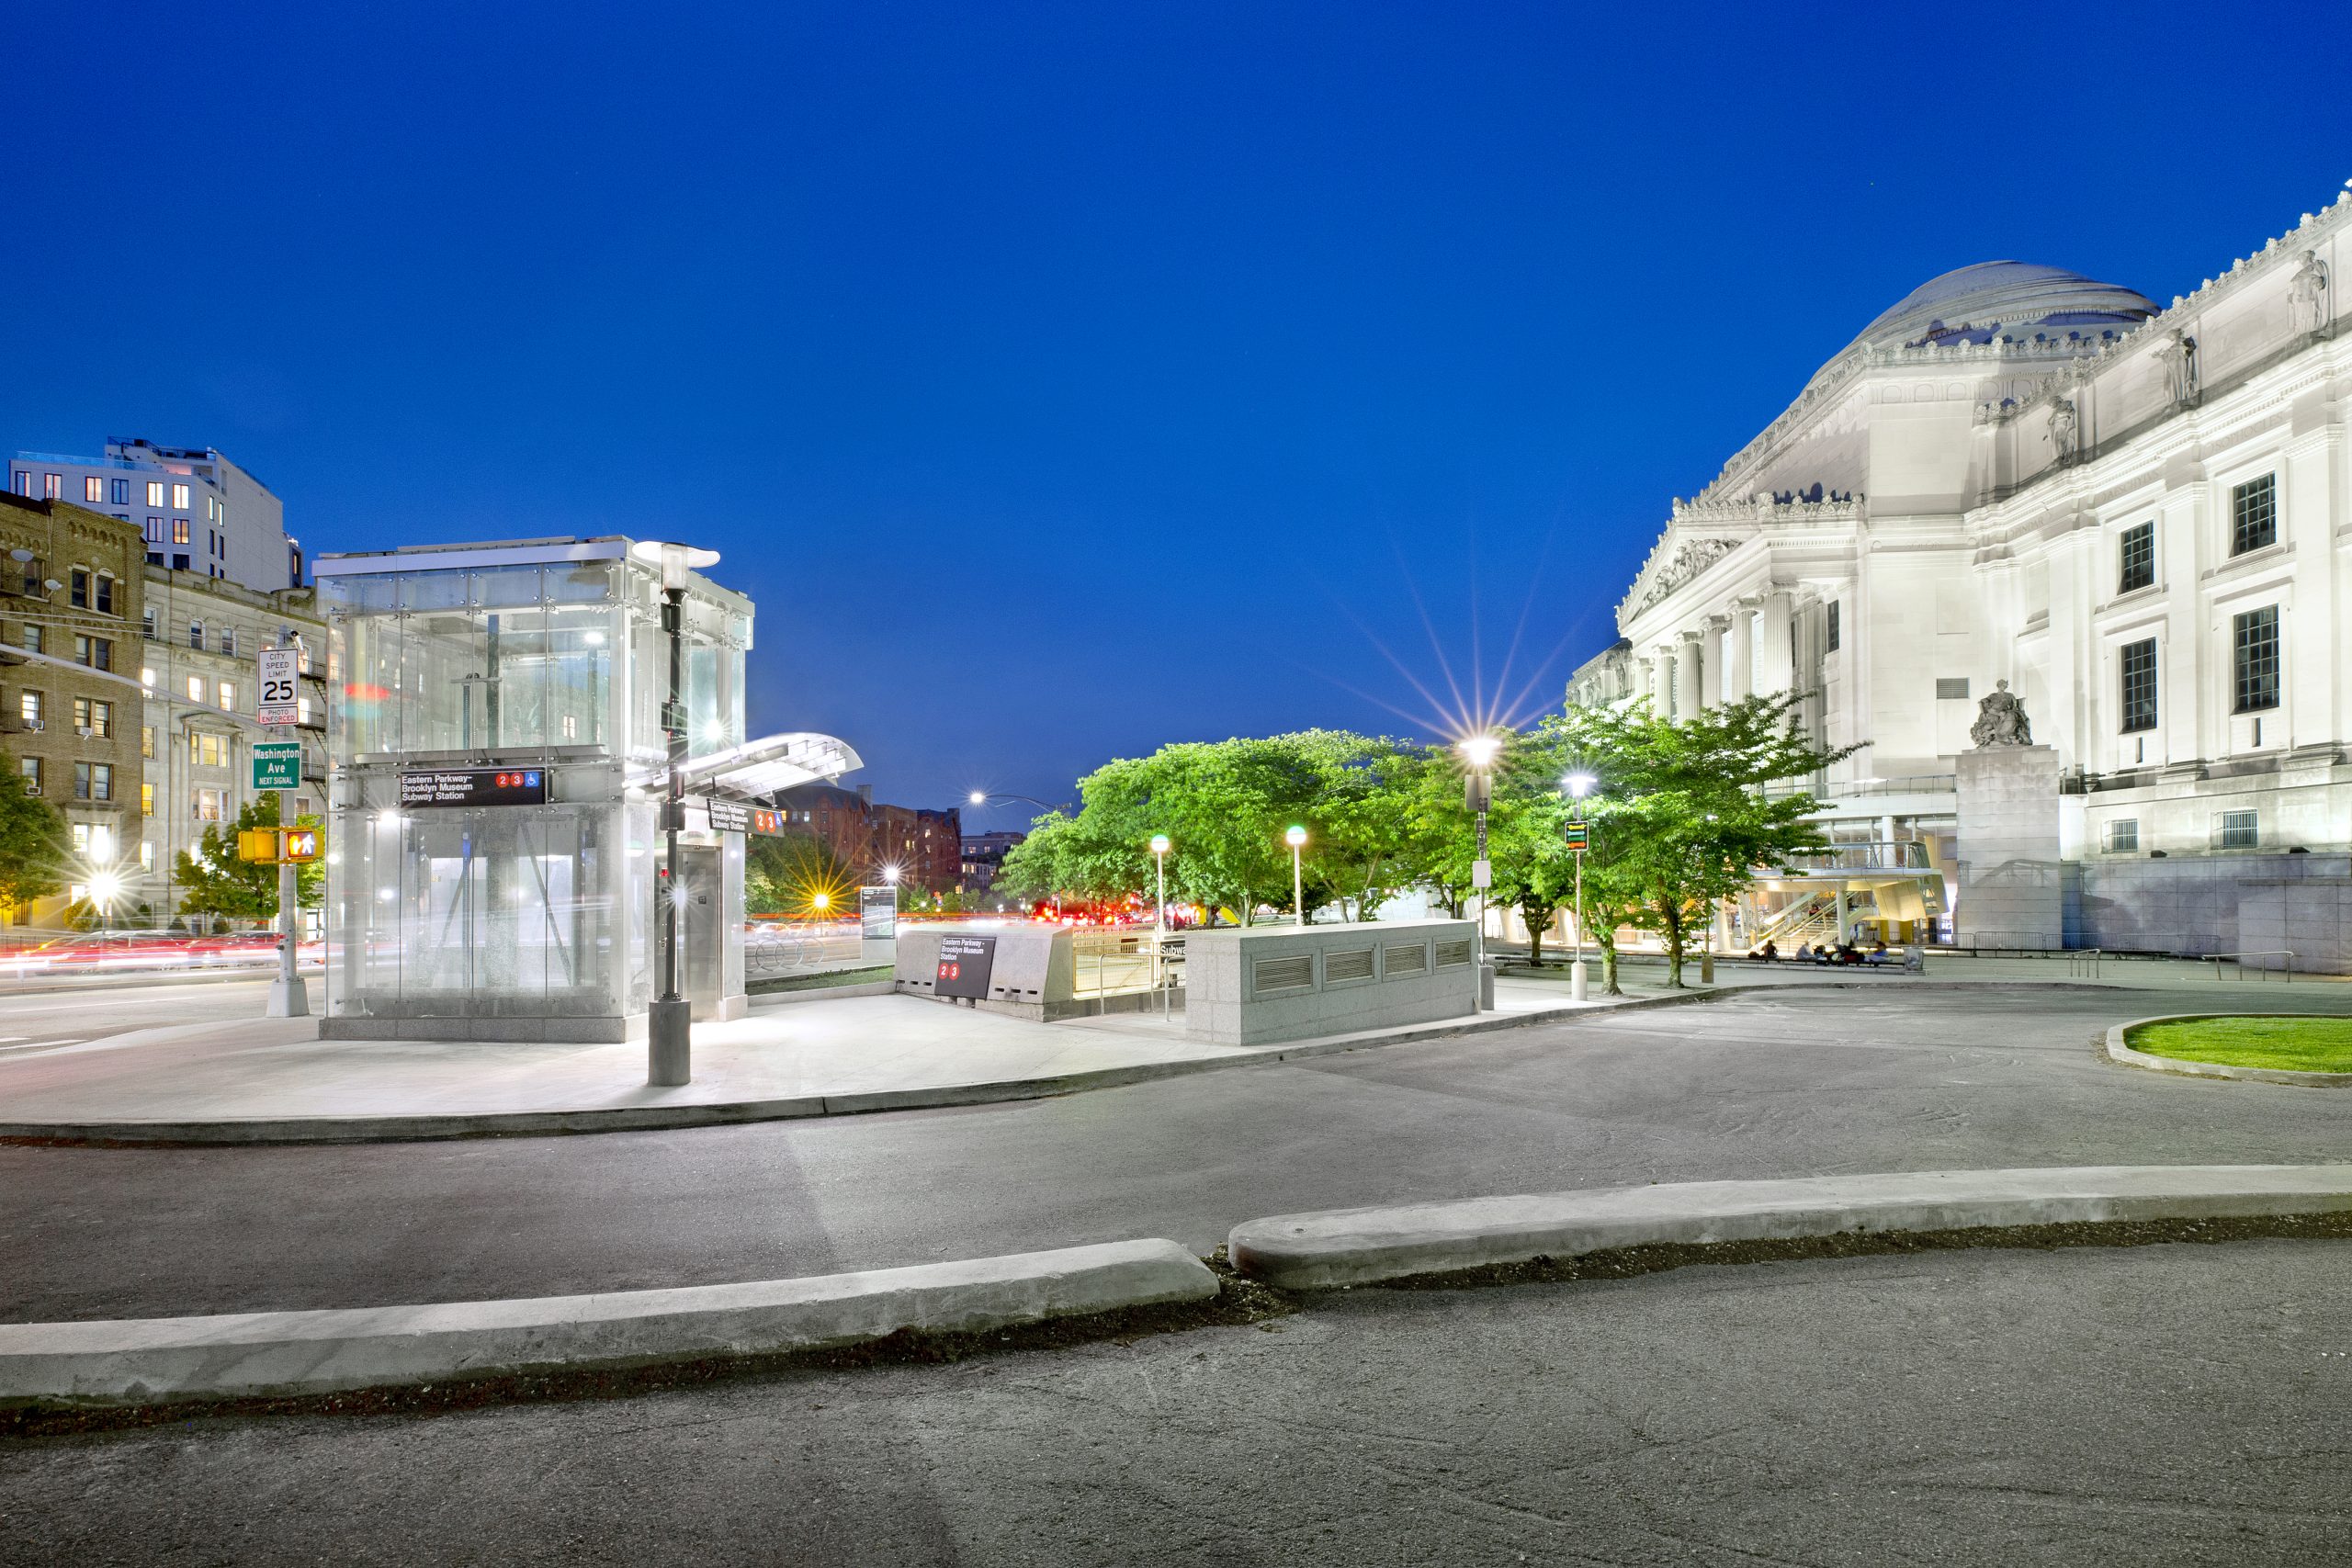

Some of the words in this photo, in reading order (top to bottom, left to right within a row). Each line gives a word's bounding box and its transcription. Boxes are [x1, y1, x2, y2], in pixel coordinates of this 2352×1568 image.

[266, 661, 289, 670] SPEED
[264, 680, 293, 701] 25
[254, 748, 300, 761] Washington
[267, 762, 286, 773] Ave
[258, 777, 273, 785] NEXT
[273, 776, 293, 784] SIGNAL
[401, 775, 433, 784] Eastern
[500, 776, 506, 784] 2
[401, 784, 437, 794] Brooklyn
[439, 783, 473, 792] Museum
[401, 793, 433, 801] Subway
[435, 792, 465, 800] Station
[710, 803, 728, 812] Eastern
[711, 811, 730, 822] Brooklyn
[731, 813, 749, 823] Museum
[758, 814, 763, 827] 2
[768, 816, 774, 828] 3
[712, 819, 729, 829] Subway
[729, 821, 745, 830] Station
[941, 945, 963, 954] Brooklyn
[963, 946, 984, 954] Museum
[941, 965, 947, 976] 2
[951, 966, 957, 976] 3
